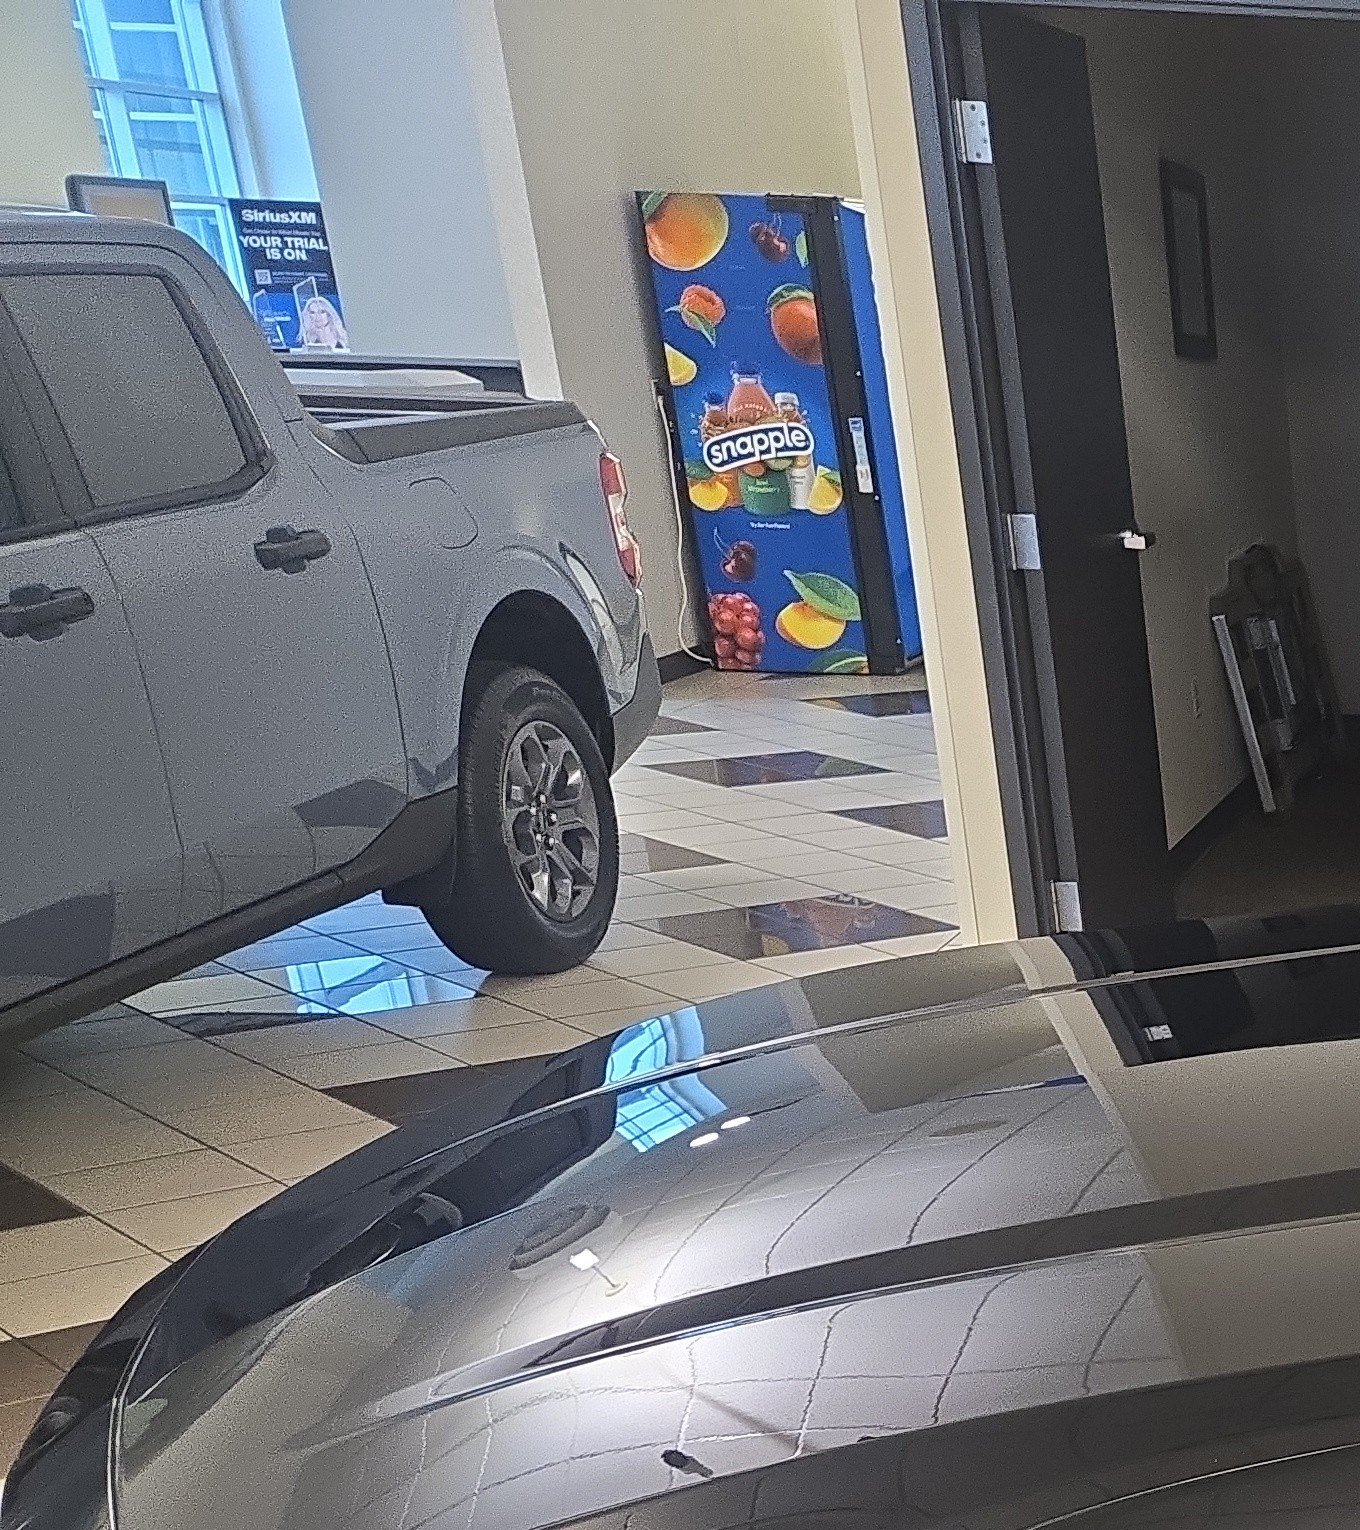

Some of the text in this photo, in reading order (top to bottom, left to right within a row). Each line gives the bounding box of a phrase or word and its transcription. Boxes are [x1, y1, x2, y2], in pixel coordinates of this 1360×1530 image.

[241, 209, 317, 224] SiriusXM
[239, 235, 328, 250] YOUR TRIAL
[265, 248, 308, 261] IS ON
[711, 423, 807, 464] snapple
